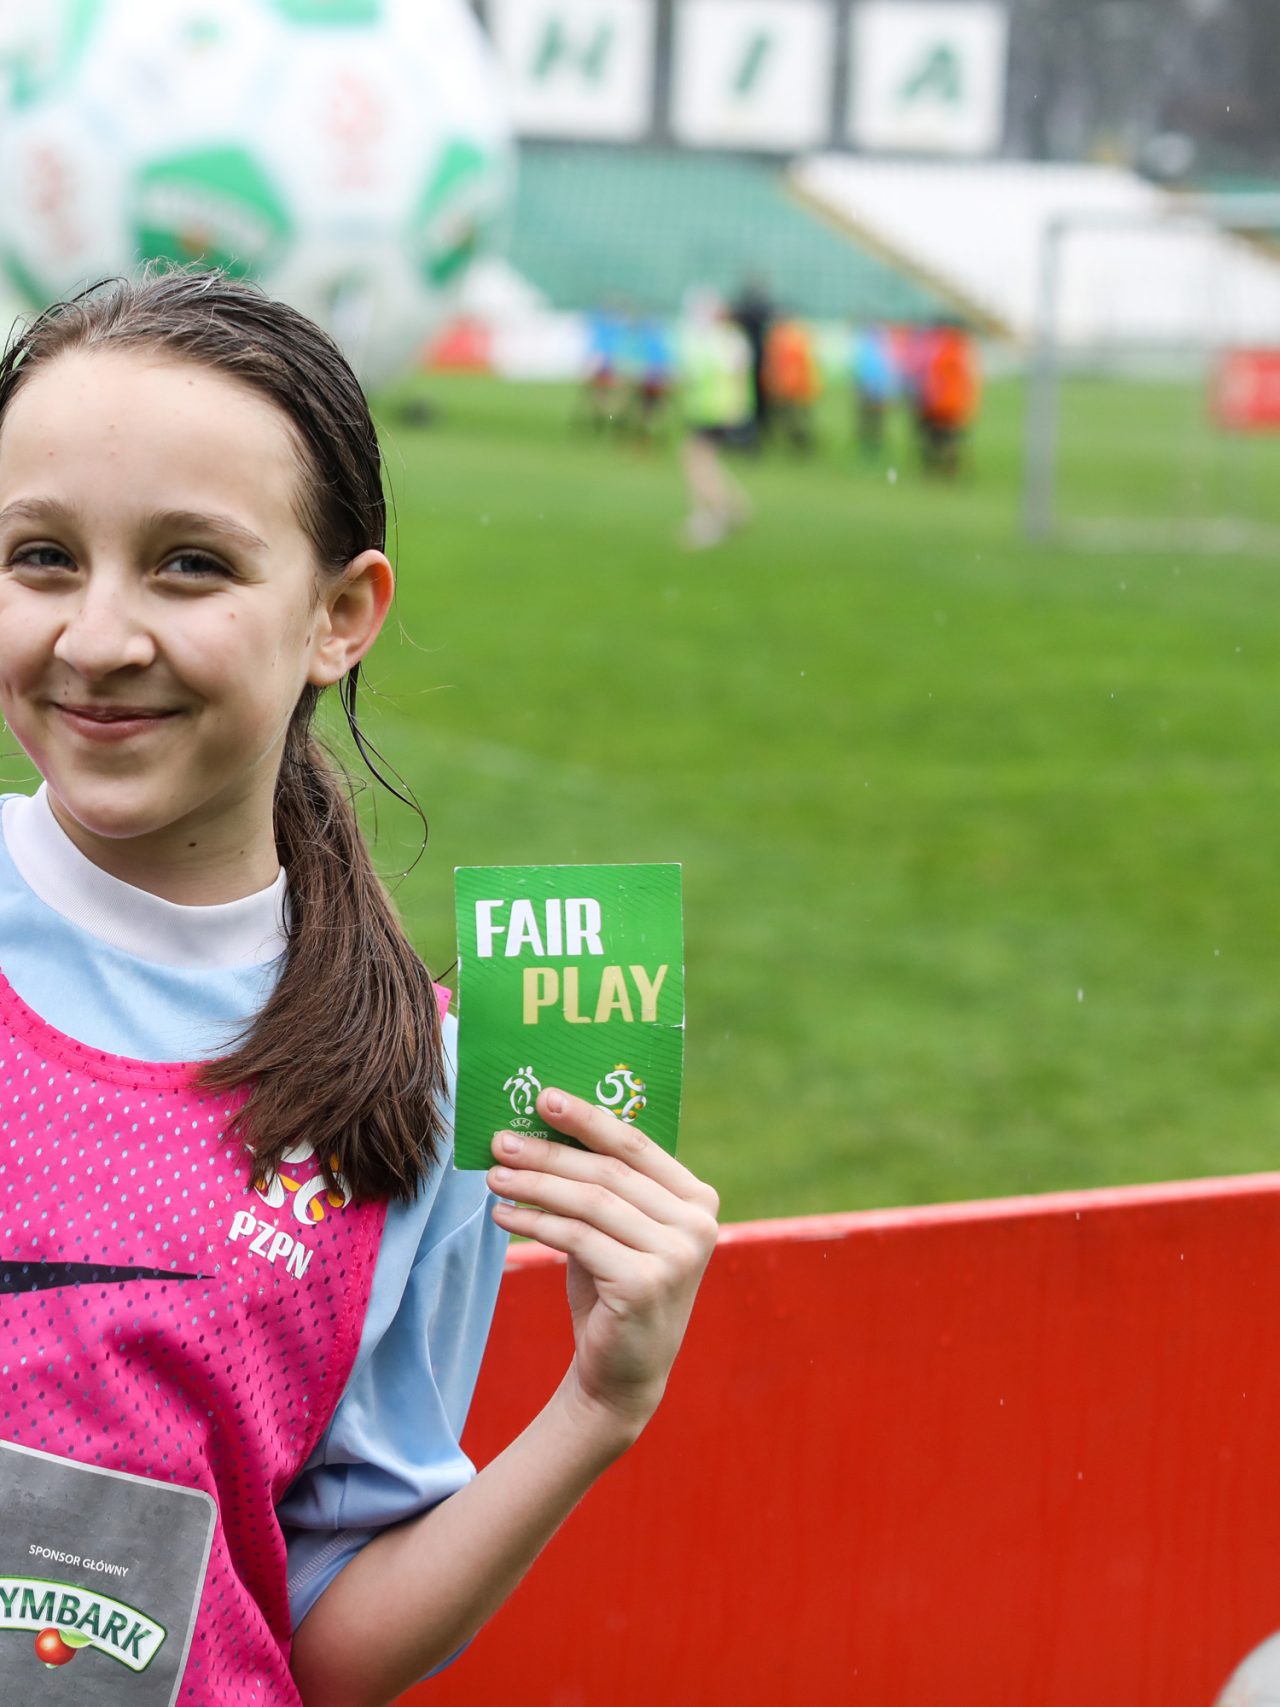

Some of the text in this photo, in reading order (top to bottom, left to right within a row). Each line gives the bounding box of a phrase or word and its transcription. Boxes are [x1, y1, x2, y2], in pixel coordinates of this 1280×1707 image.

[474, 897, 604, 958] FAIR
[522, 964, 669, 1025] PLAY
[228, 1210, 314, 1280] PZPN
[29, 1544, 129, 1577] SPONSOR GŁÓWNY
